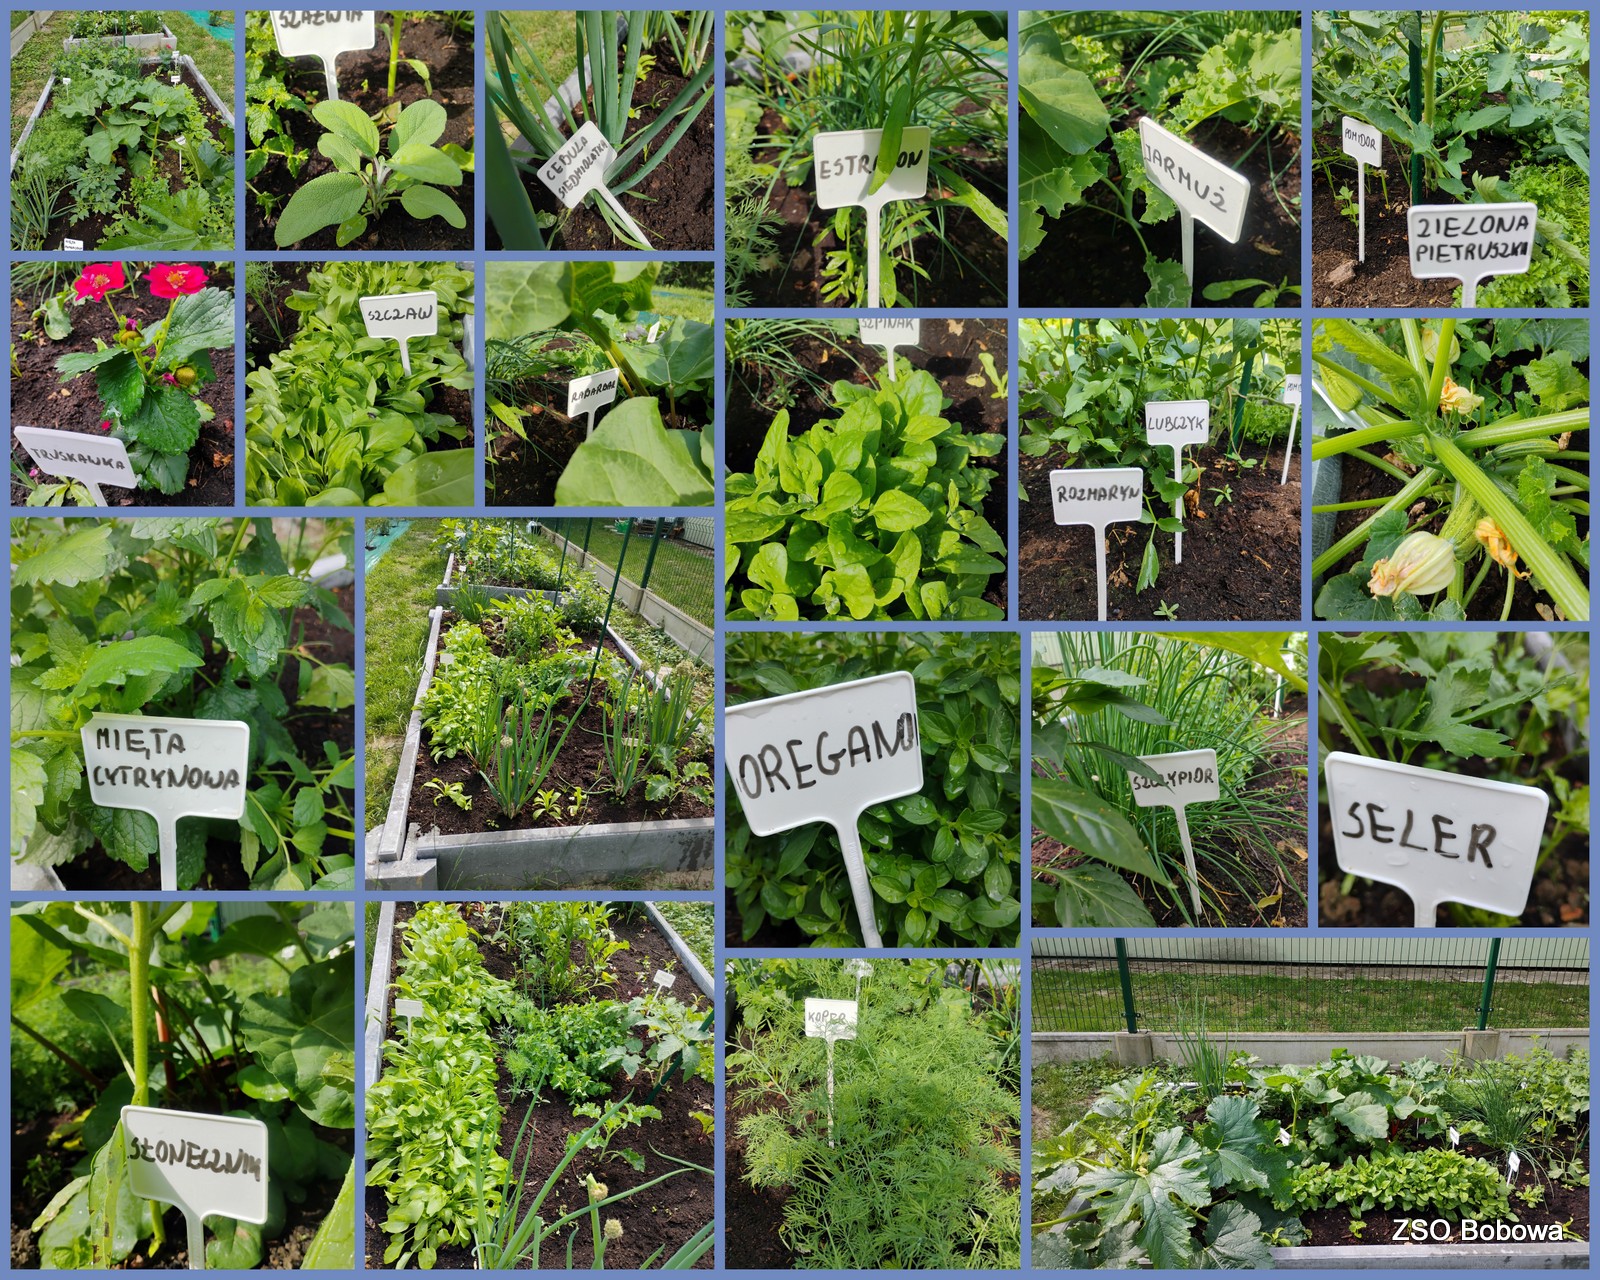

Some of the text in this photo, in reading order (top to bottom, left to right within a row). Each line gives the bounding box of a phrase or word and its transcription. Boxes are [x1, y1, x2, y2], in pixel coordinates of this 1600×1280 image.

[1345, 127, 1377, 150] POMIDOR
[546, 136, 588, 180] CEBULA
[558, 139, 608, 199] SIEDMIOLATKA
[820, 149, 923, 179] ESTRON
[1144, 143, 1228, 213] JARMUŻ
[368, 304, 433, 321] SZCZAW
[1148, 416, 1205, 432] LUBCZYK
[30, 447, 125, 470] TRUSKAWKA
[1056, 484, 1140, 503] ROZMARYN
[96, 727, 187, 760] MIĘTA
[738, 712, 915, 799] OREGANO
[93, 764, 240, 790] CYTRYNOWA
[1342, 801, 1497, 869] SELER
